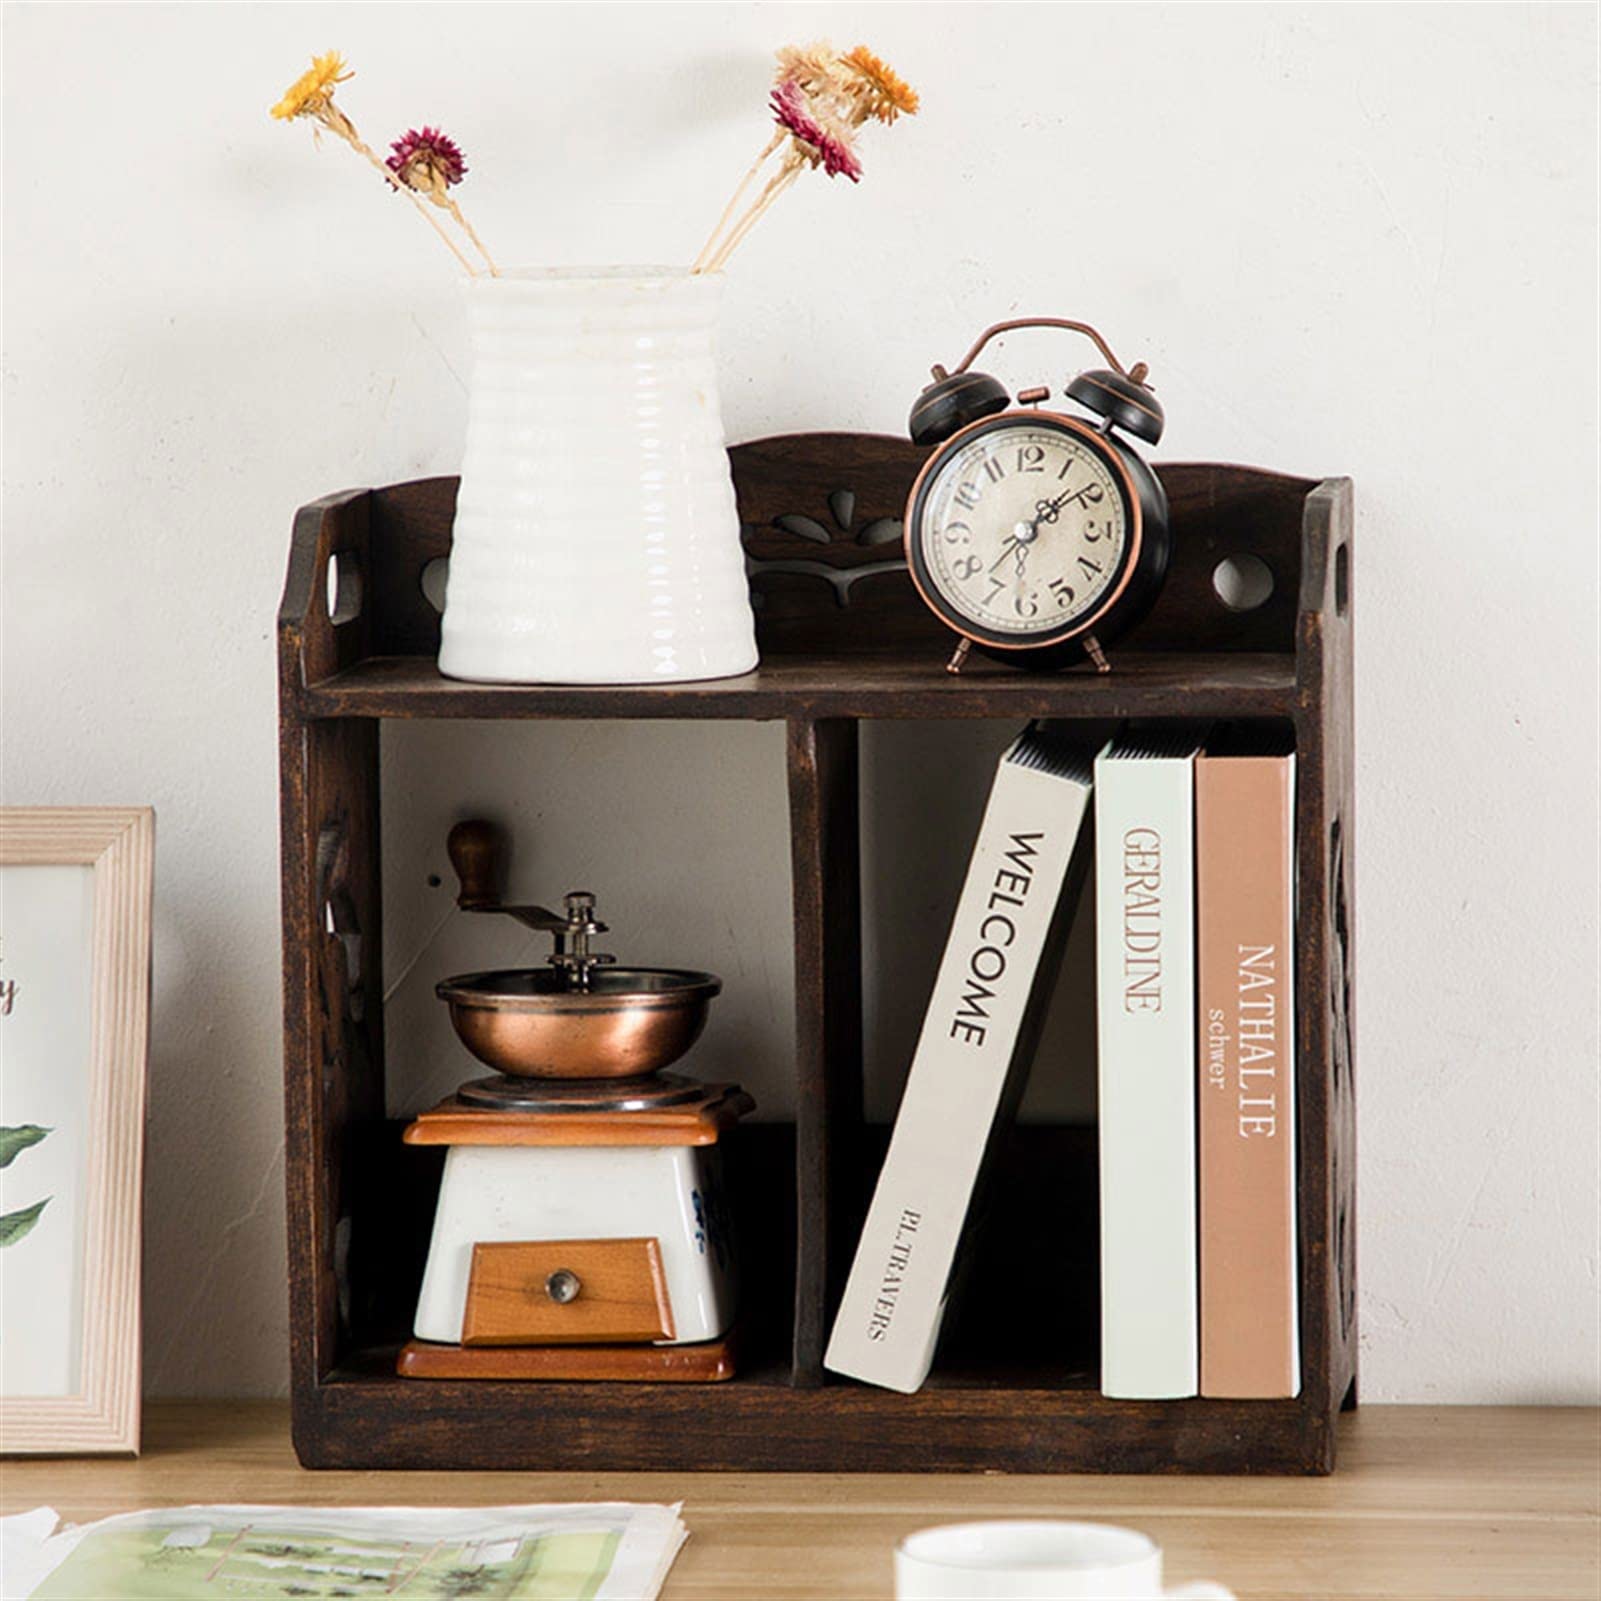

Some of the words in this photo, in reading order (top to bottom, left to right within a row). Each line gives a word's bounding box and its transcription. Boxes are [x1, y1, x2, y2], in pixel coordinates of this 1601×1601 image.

[984, 457, 1005, 483] 11
[1017, 446, 1045, 472] 12
[1058, 458, 1074, 480] 1
[953, 481, 981, 511] 10
[1077, 482, 1104, 509] 2
[944, 521, 970, 544] 9
[1083, 521, 1112, 543] 3
[953, 555, 983, 581] 8
[1077, 556, 1102, 582] 4
[982, 576, 1006, 606] 7
[1015, 591, 1039, 618] 6
[1048, 578, 1075, 608] 5
[1123, 827, 1162, 1014] GERALDINE
[949, 832, 1045, 1048] WELCOME
[1208, 1008, 1232, 1090] schwer
[1238, 944, 1276, 1139] NATHALIE
